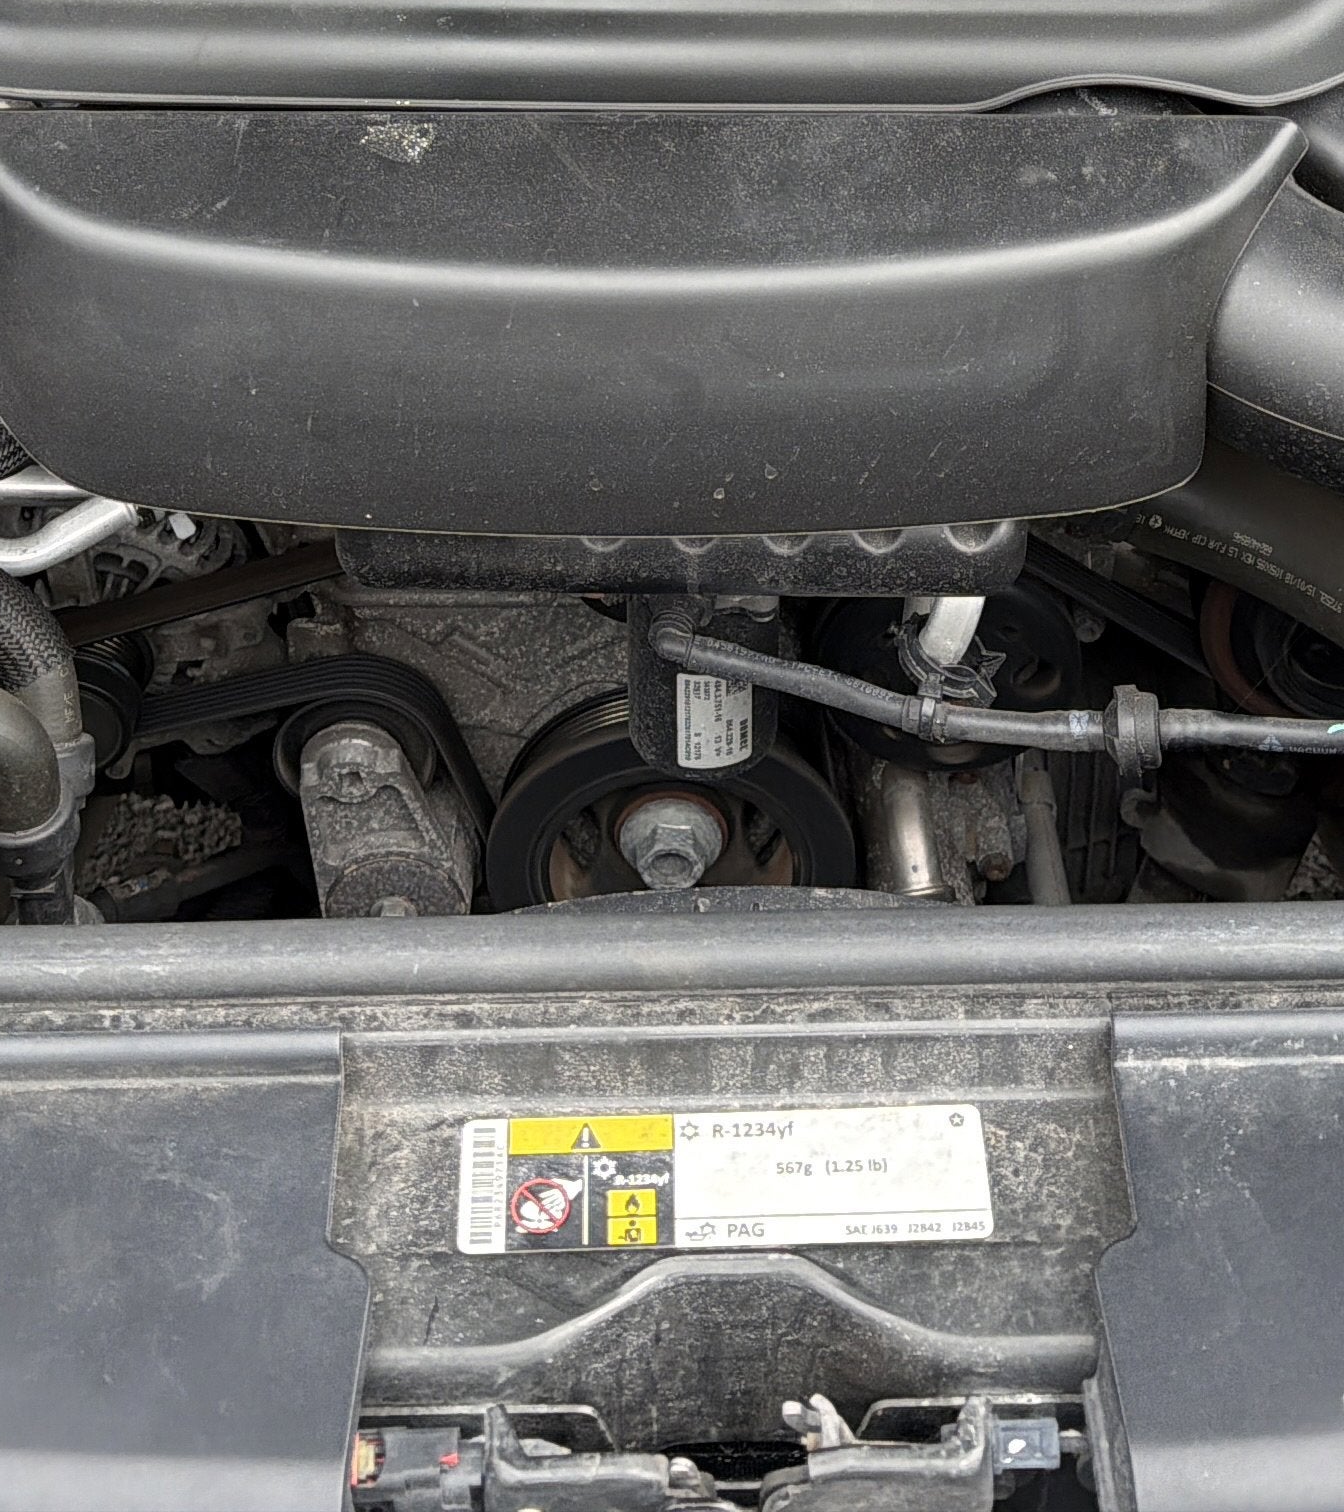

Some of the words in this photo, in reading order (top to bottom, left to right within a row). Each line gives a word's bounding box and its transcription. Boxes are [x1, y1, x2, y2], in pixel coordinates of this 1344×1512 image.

[712, 1119, 795, 1139] R-1234yf
[776, 1157, 813, 1177] 567g
[825, 1157, 863, 1175] (1.25
[867, 1156, 889, 1174] lb)
[727, 1222, 765, 1239] PAG
[846, 1224, 867, 1235] SAE
